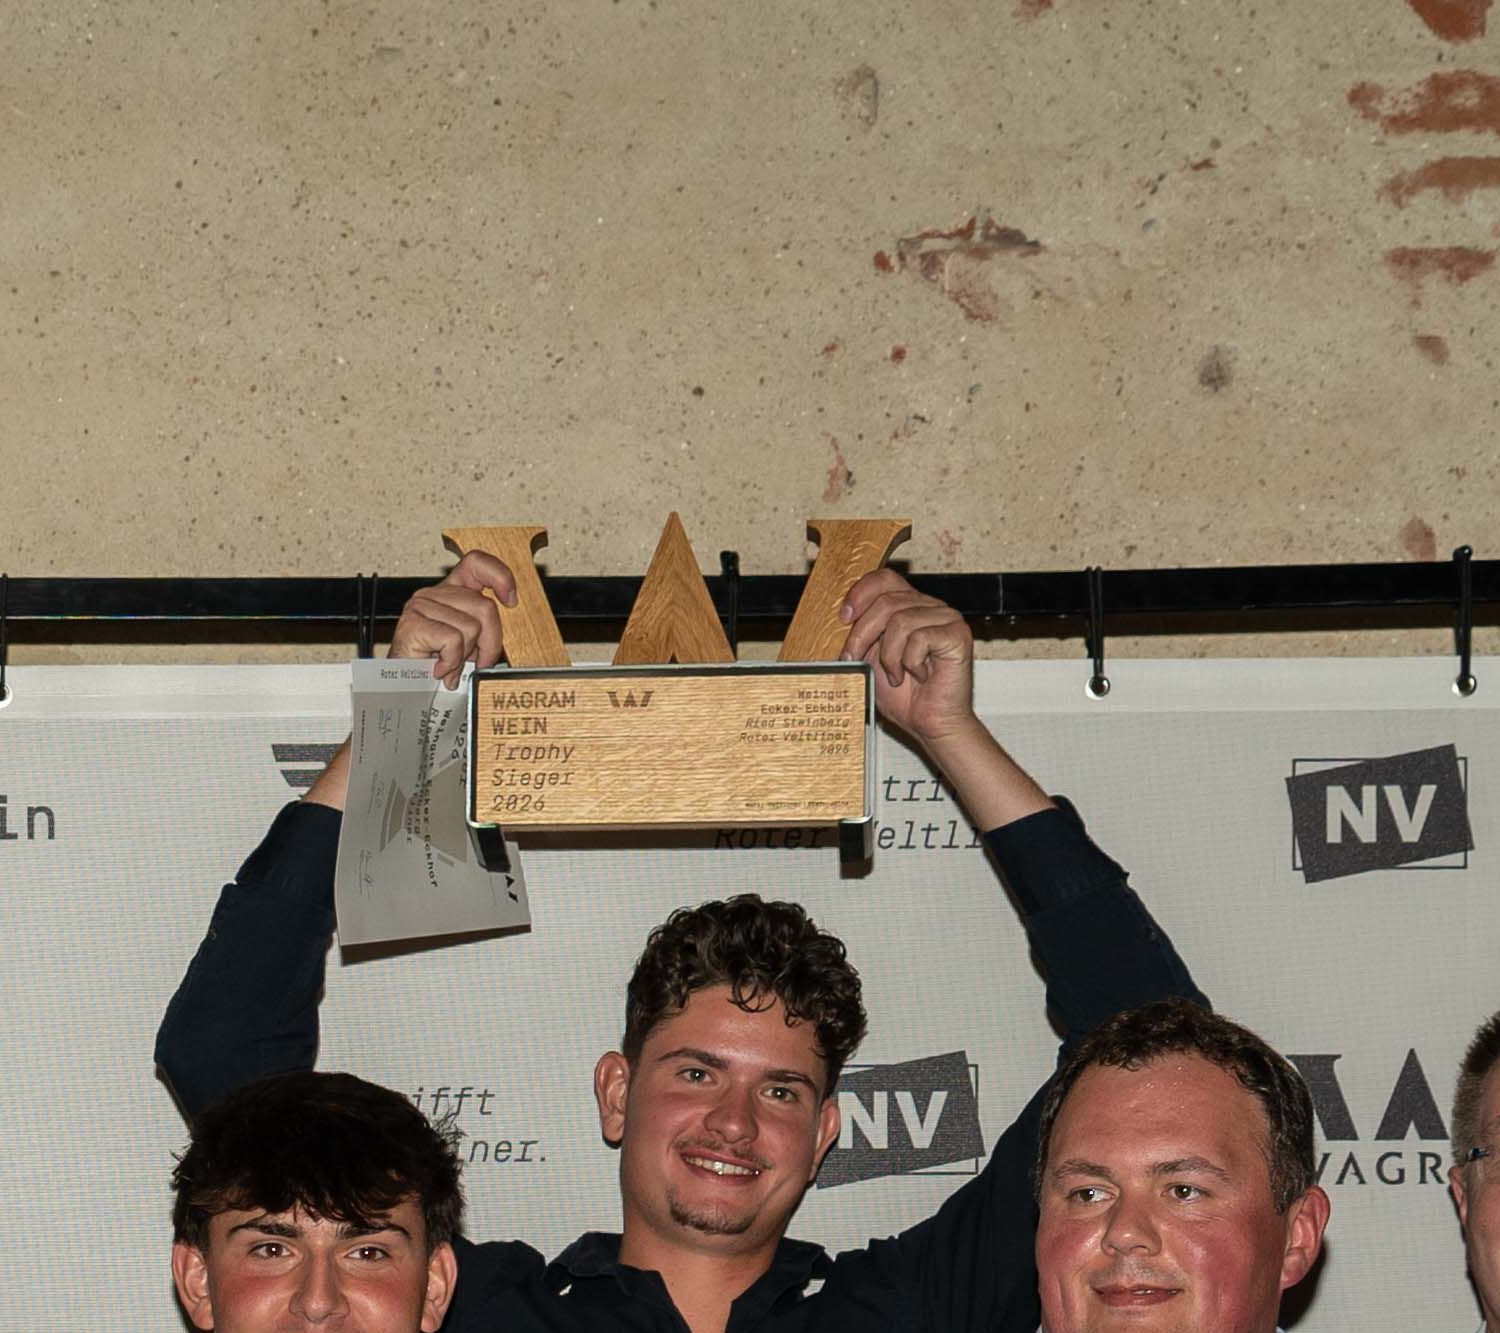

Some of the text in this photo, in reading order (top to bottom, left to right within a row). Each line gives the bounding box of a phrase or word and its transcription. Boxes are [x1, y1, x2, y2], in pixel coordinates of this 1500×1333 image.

[491, 690, 576, 709] WAGRAM
[491, 717, 548, 736] WEIN
[492, 742, 576, 764] Trophy
[491, 768, 576, 791] Sieger
[492, 794, 546, 813] 2026
[1324, 784, 1438, 844] NV
[838, 1091, 948, 1150] NV
[1313, 1151, 1450, 1186] AGR
